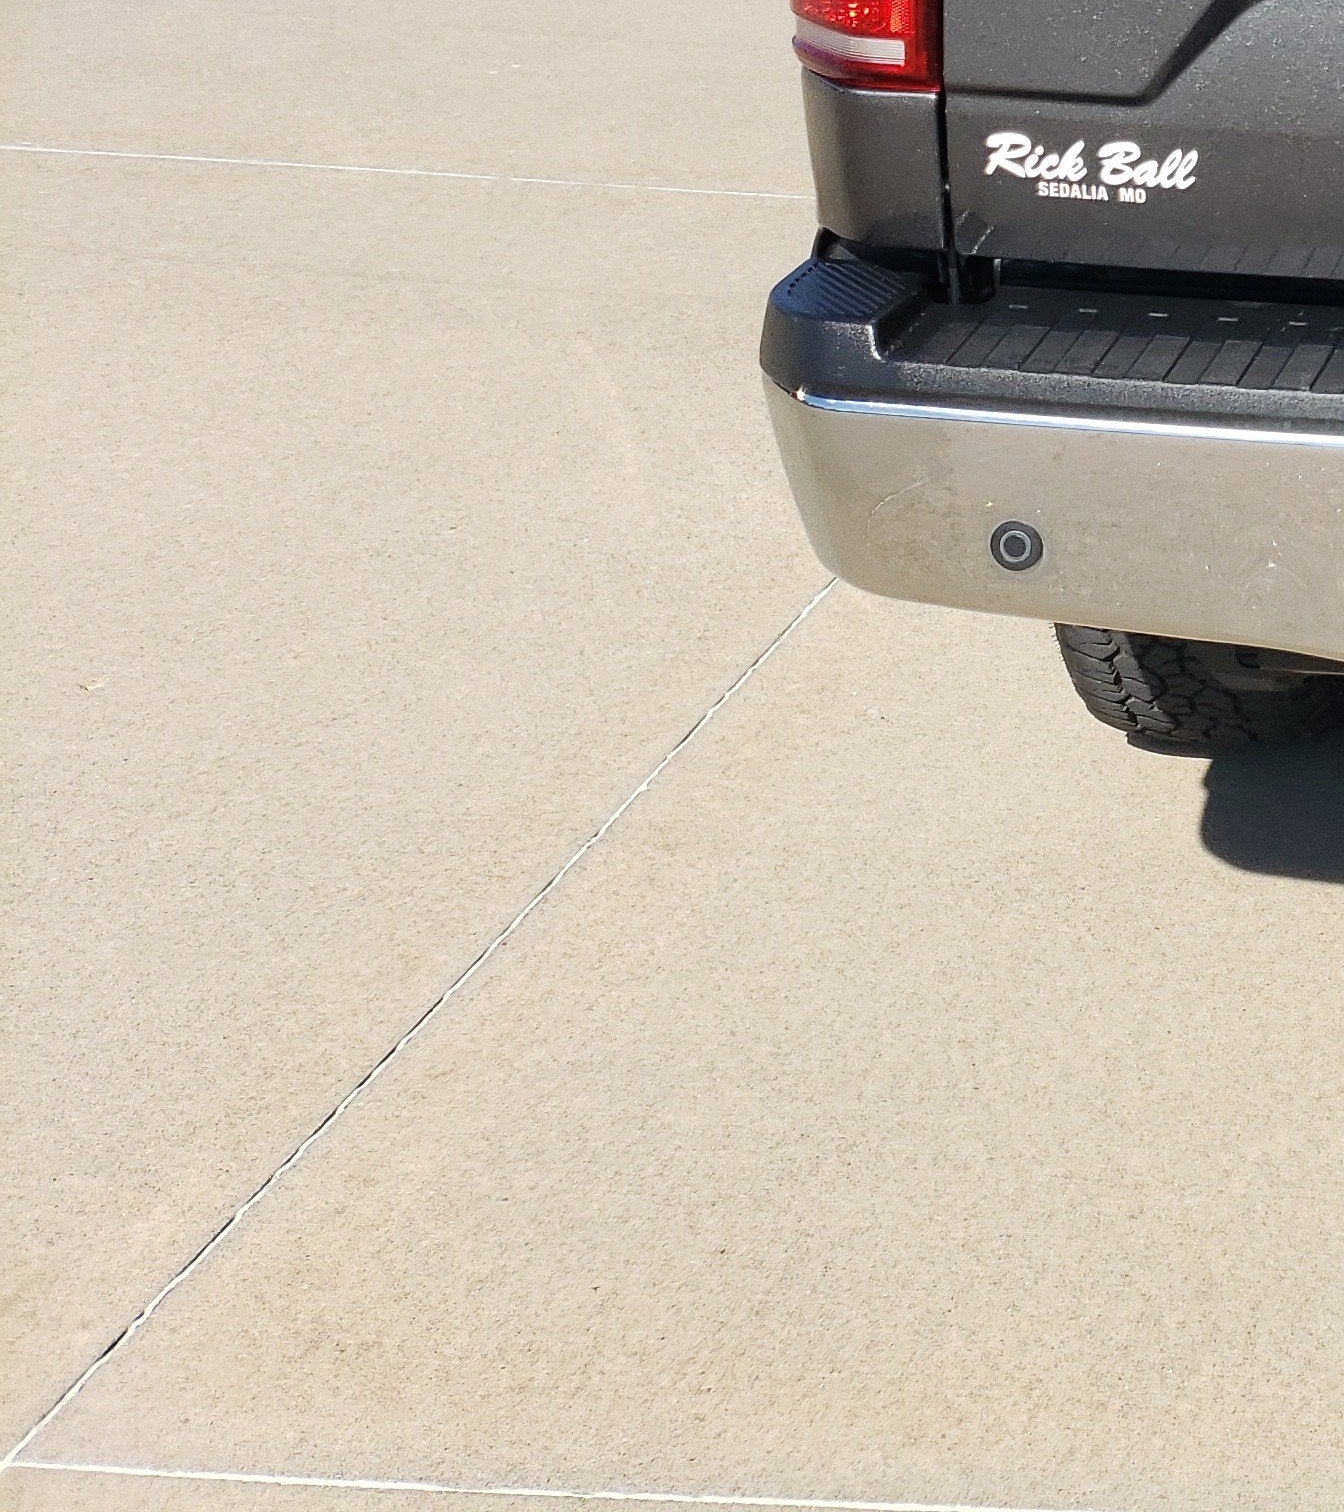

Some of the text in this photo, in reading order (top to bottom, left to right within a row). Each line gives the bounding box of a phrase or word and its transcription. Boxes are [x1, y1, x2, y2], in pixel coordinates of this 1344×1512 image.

[985, 131, 1199, 190] Rick Ball
[1037, 181, 1147, 204] SEDALIA MO
